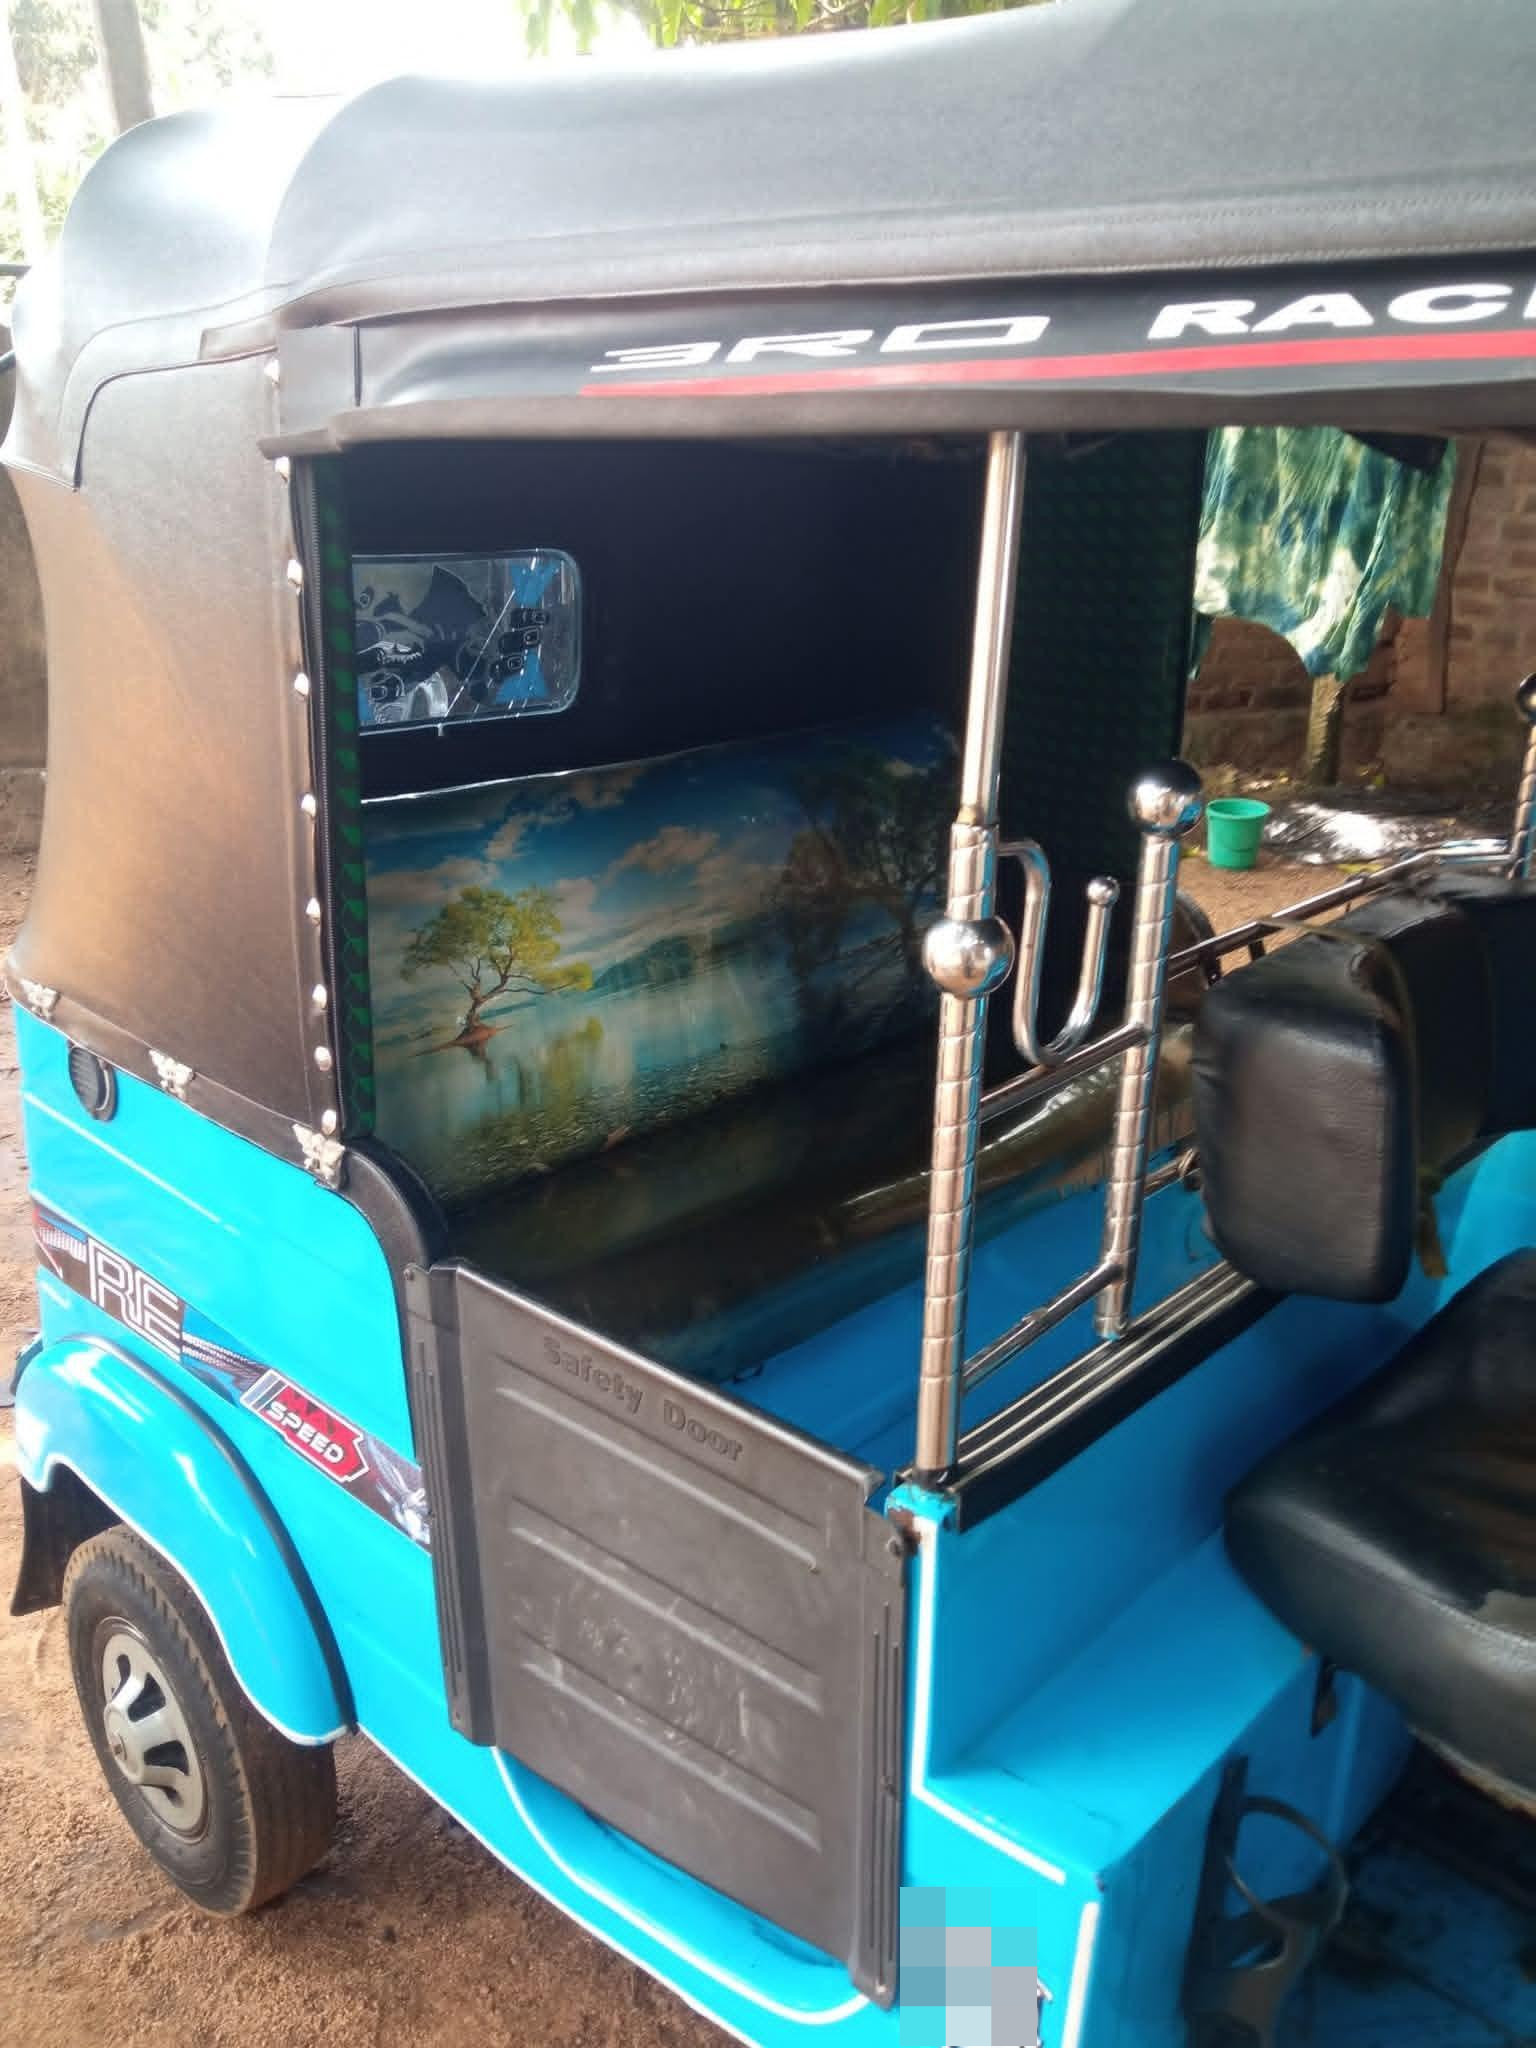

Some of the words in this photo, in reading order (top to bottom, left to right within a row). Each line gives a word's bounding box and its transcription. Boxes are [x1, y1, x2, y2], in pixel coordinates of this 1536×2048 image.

[87, 1236, 182, 1361] RE
[265, 1401, 344, 1463] SPEED
[544, 1337, 643, 1414] Safety
[664, 1400, 744, 1461] Door
